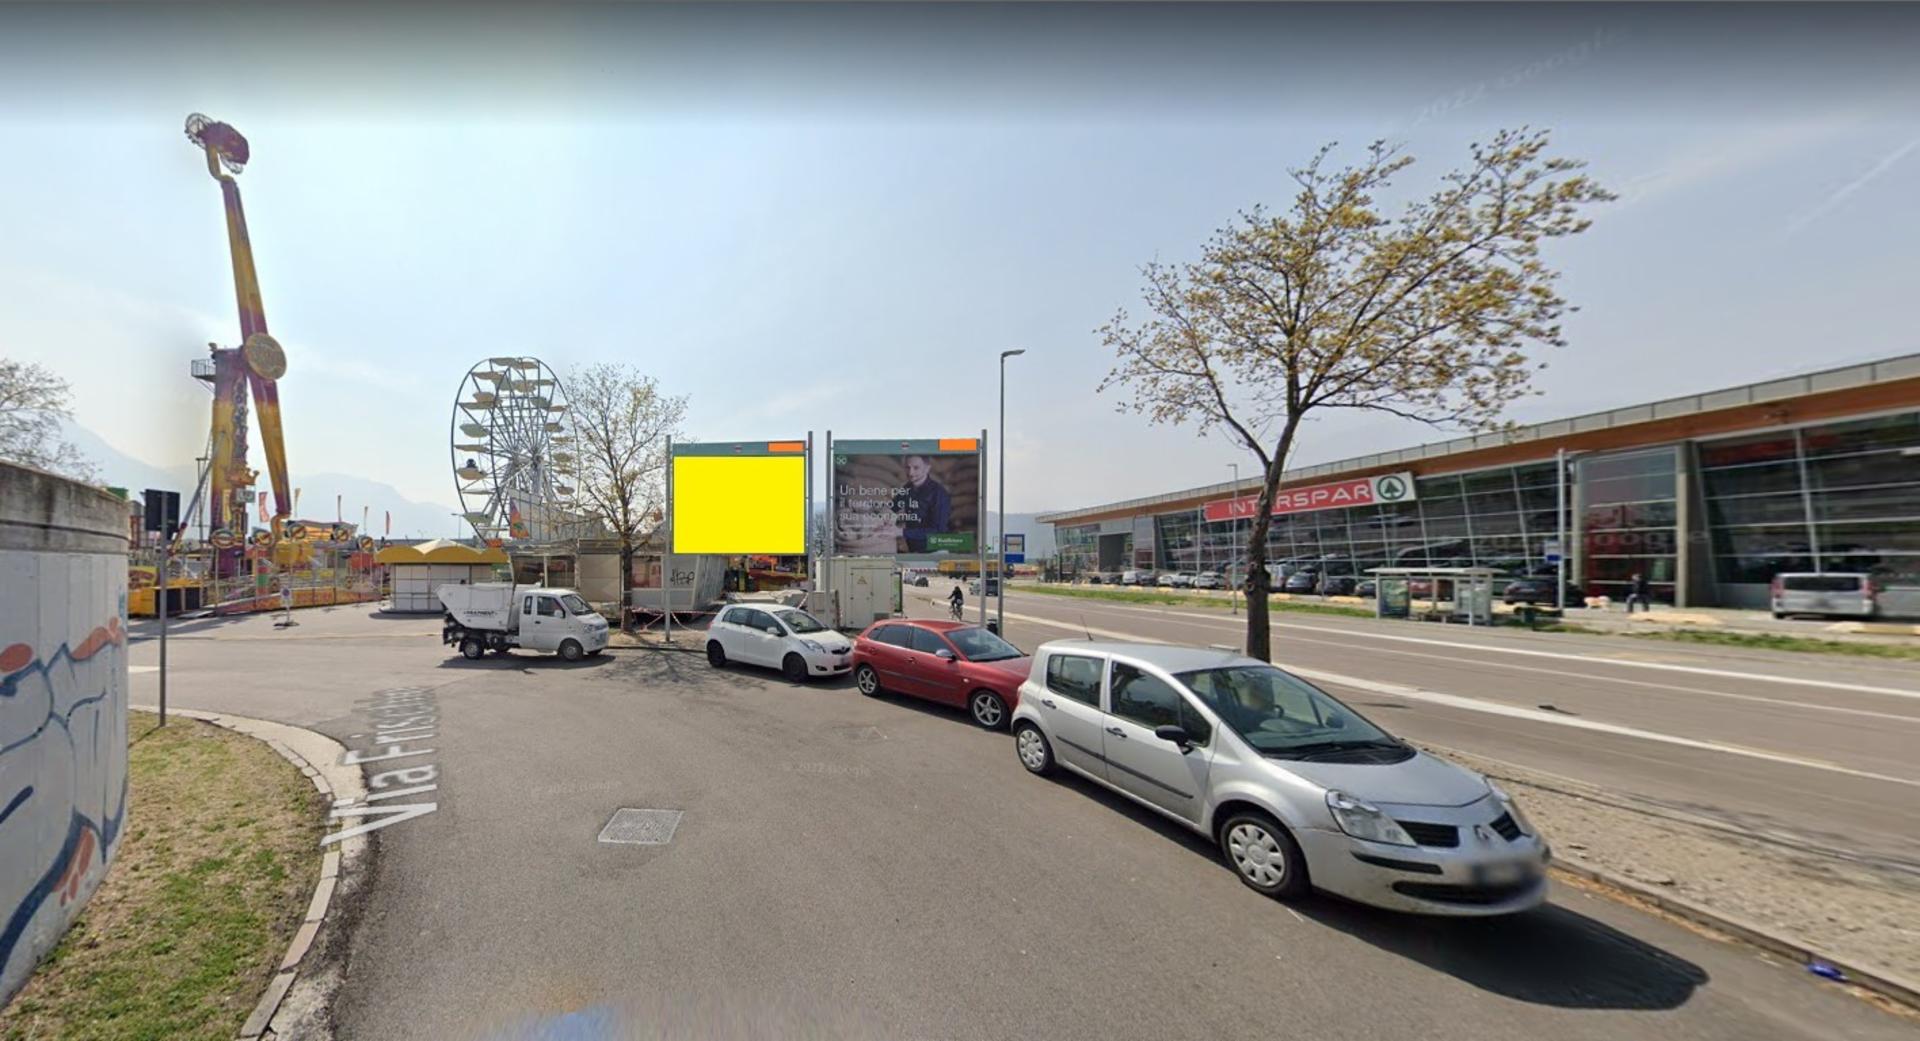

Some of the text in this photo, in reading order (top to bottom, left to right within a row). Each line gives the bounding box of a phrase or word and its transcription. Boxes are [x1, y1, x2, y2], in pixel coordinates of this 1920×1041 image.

[840, 484, 911, 498] Un bene per
[897, 499, 906, 508] e
[909, 497, 919, 509] la
[1228, 484, 1370, 515] INTRSPAR
